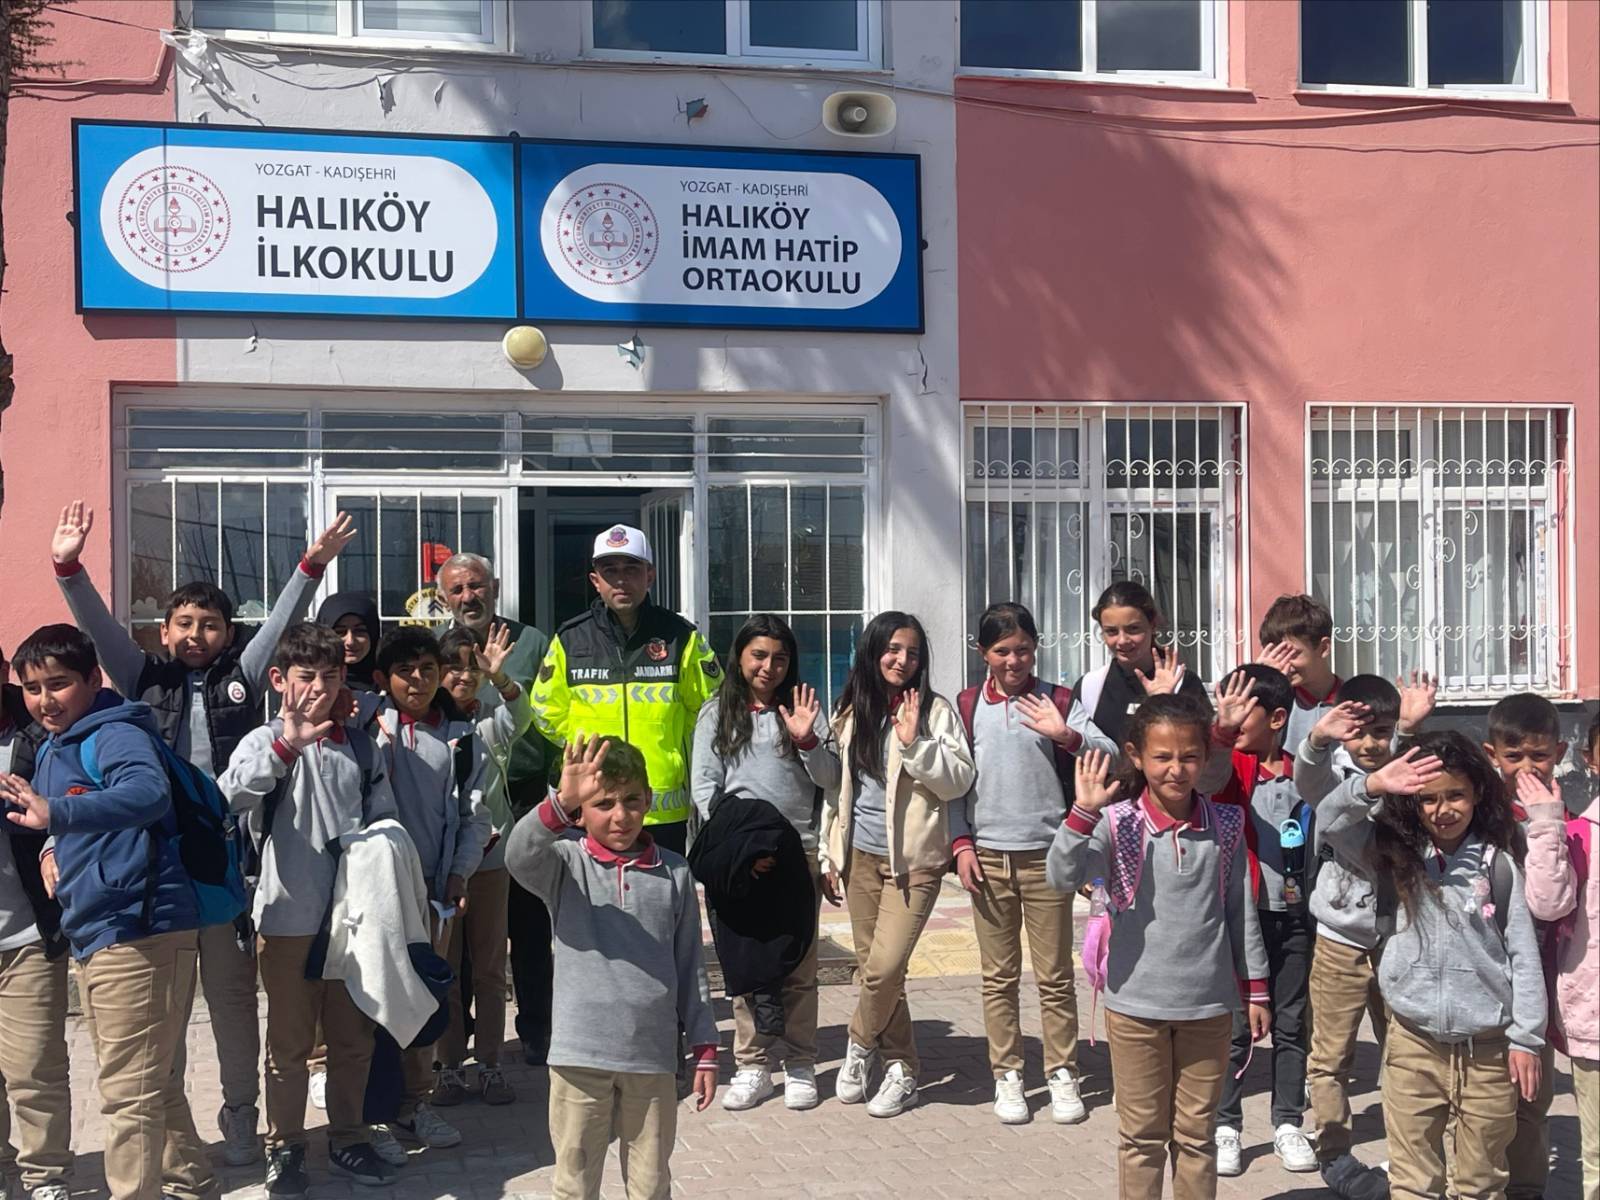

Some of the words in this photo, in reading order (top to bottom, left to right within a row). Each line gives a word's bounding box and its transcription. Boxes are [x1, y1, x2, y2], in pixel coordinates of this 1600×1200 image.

[255, 163, 312, 177] YOZGAT
[323, 165, 396, 183] KADIŞEHRİ
[680, 180, 732, 194] YOZGAT
[742, 182, 809, 198] KADIŞEHRİ
[257, 191, 430, 233] HALIKÖY
[682, 201, 810, 231] HALIKÖY
[257, 236, 454, 283] İLKOKULU
[682, 230, 766, 261] İMAM
[775, 234, 859, 263] HATİP
[682, 267, 861, 294] ORTAOKULU
[570, 668, 610, 680] TRAFIK
